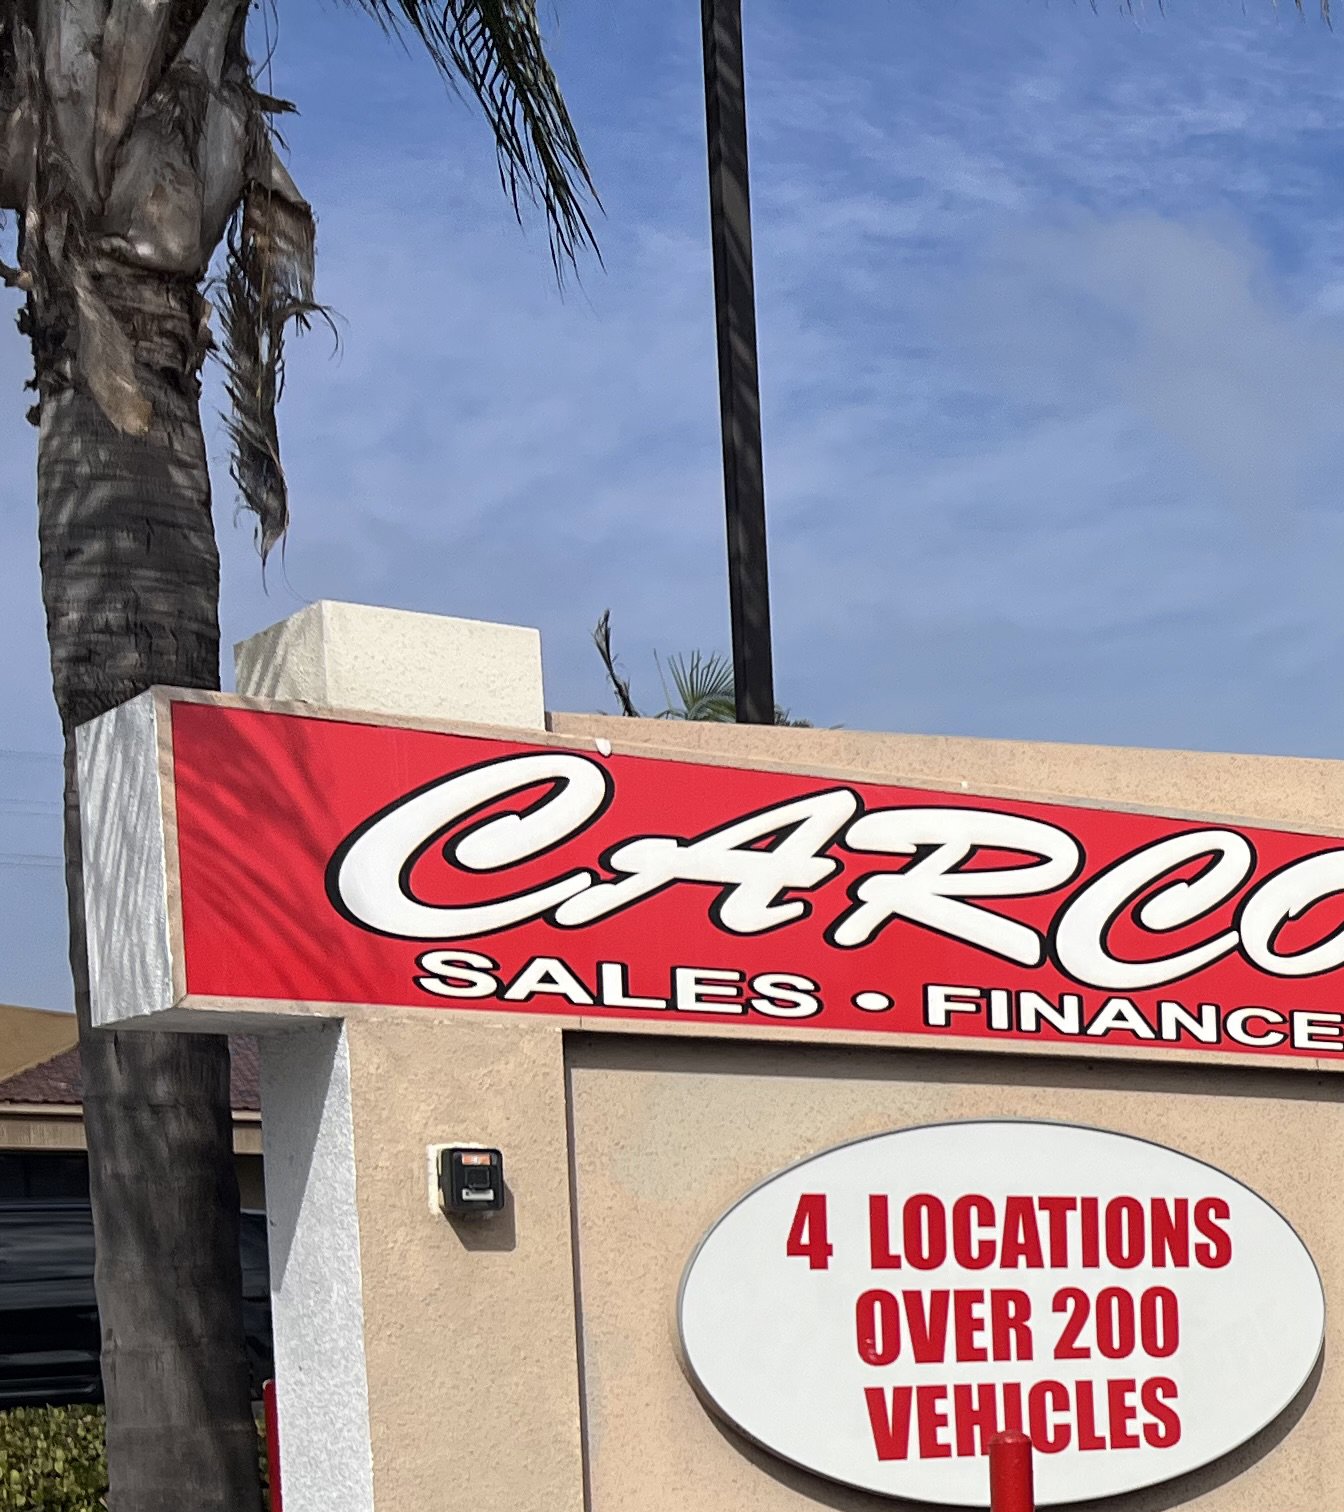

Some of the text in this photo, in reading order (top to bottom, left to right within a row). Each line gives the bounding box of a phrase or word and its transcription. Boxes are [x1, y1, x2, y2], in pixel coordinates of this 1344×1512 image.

[417, 946, 821, 1020] SALES
[786, 1194, 1232, 1271] 4 LOCATIONS
[855, 1286, 1180, 1367] OVER 200
[864, 1376, 1181, 1461] VEHICLES
